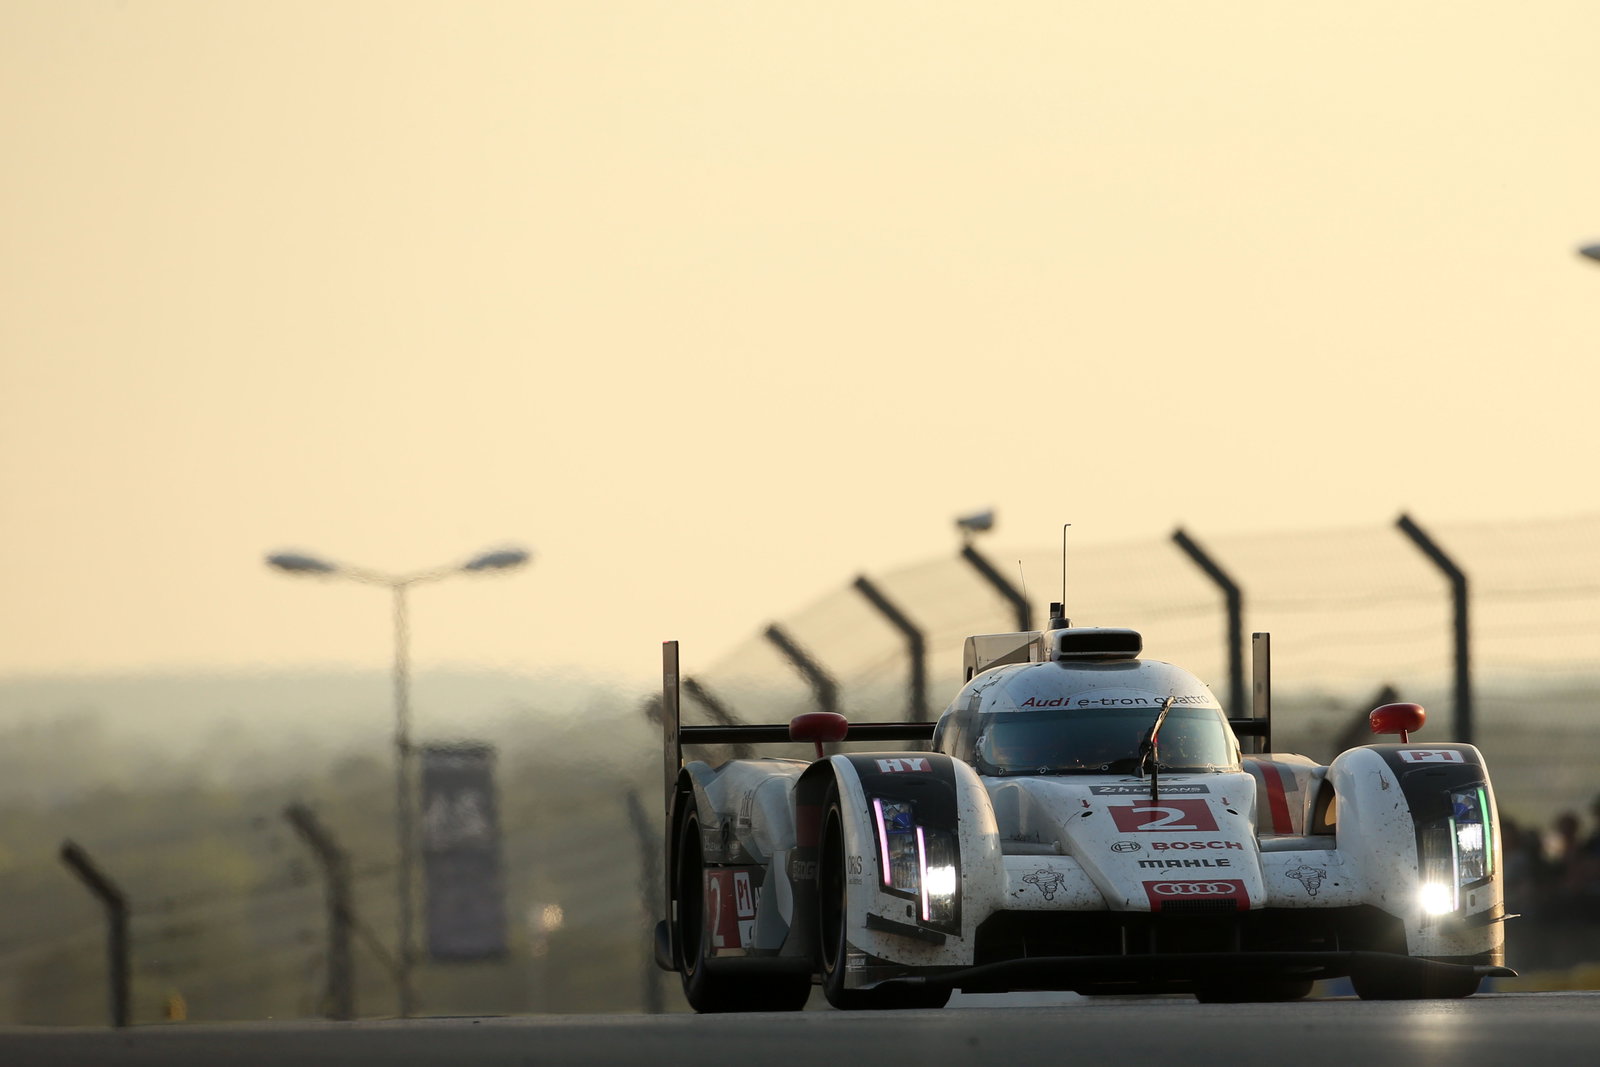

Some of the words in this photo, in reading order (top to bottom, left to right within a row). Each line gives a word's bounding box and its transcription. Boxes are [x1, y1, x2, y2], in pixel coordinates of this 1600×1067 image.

[1021, 696, 1071, 708] Audi
[1077, 697, 1148, 707] e-tron
[1153, 694, 1210, 706] qattro
[1411, 751, 1454, 761] P1
[877, 758, 923, 773] HY
[1131, 806, 1198, 831] 2
[1151, 841, 1244, 851] BOSCH
[1138, 858, 1231, 869] MAHLE
[737, 879, 751, 911] P1
[710, 876, 725, 947] 2
